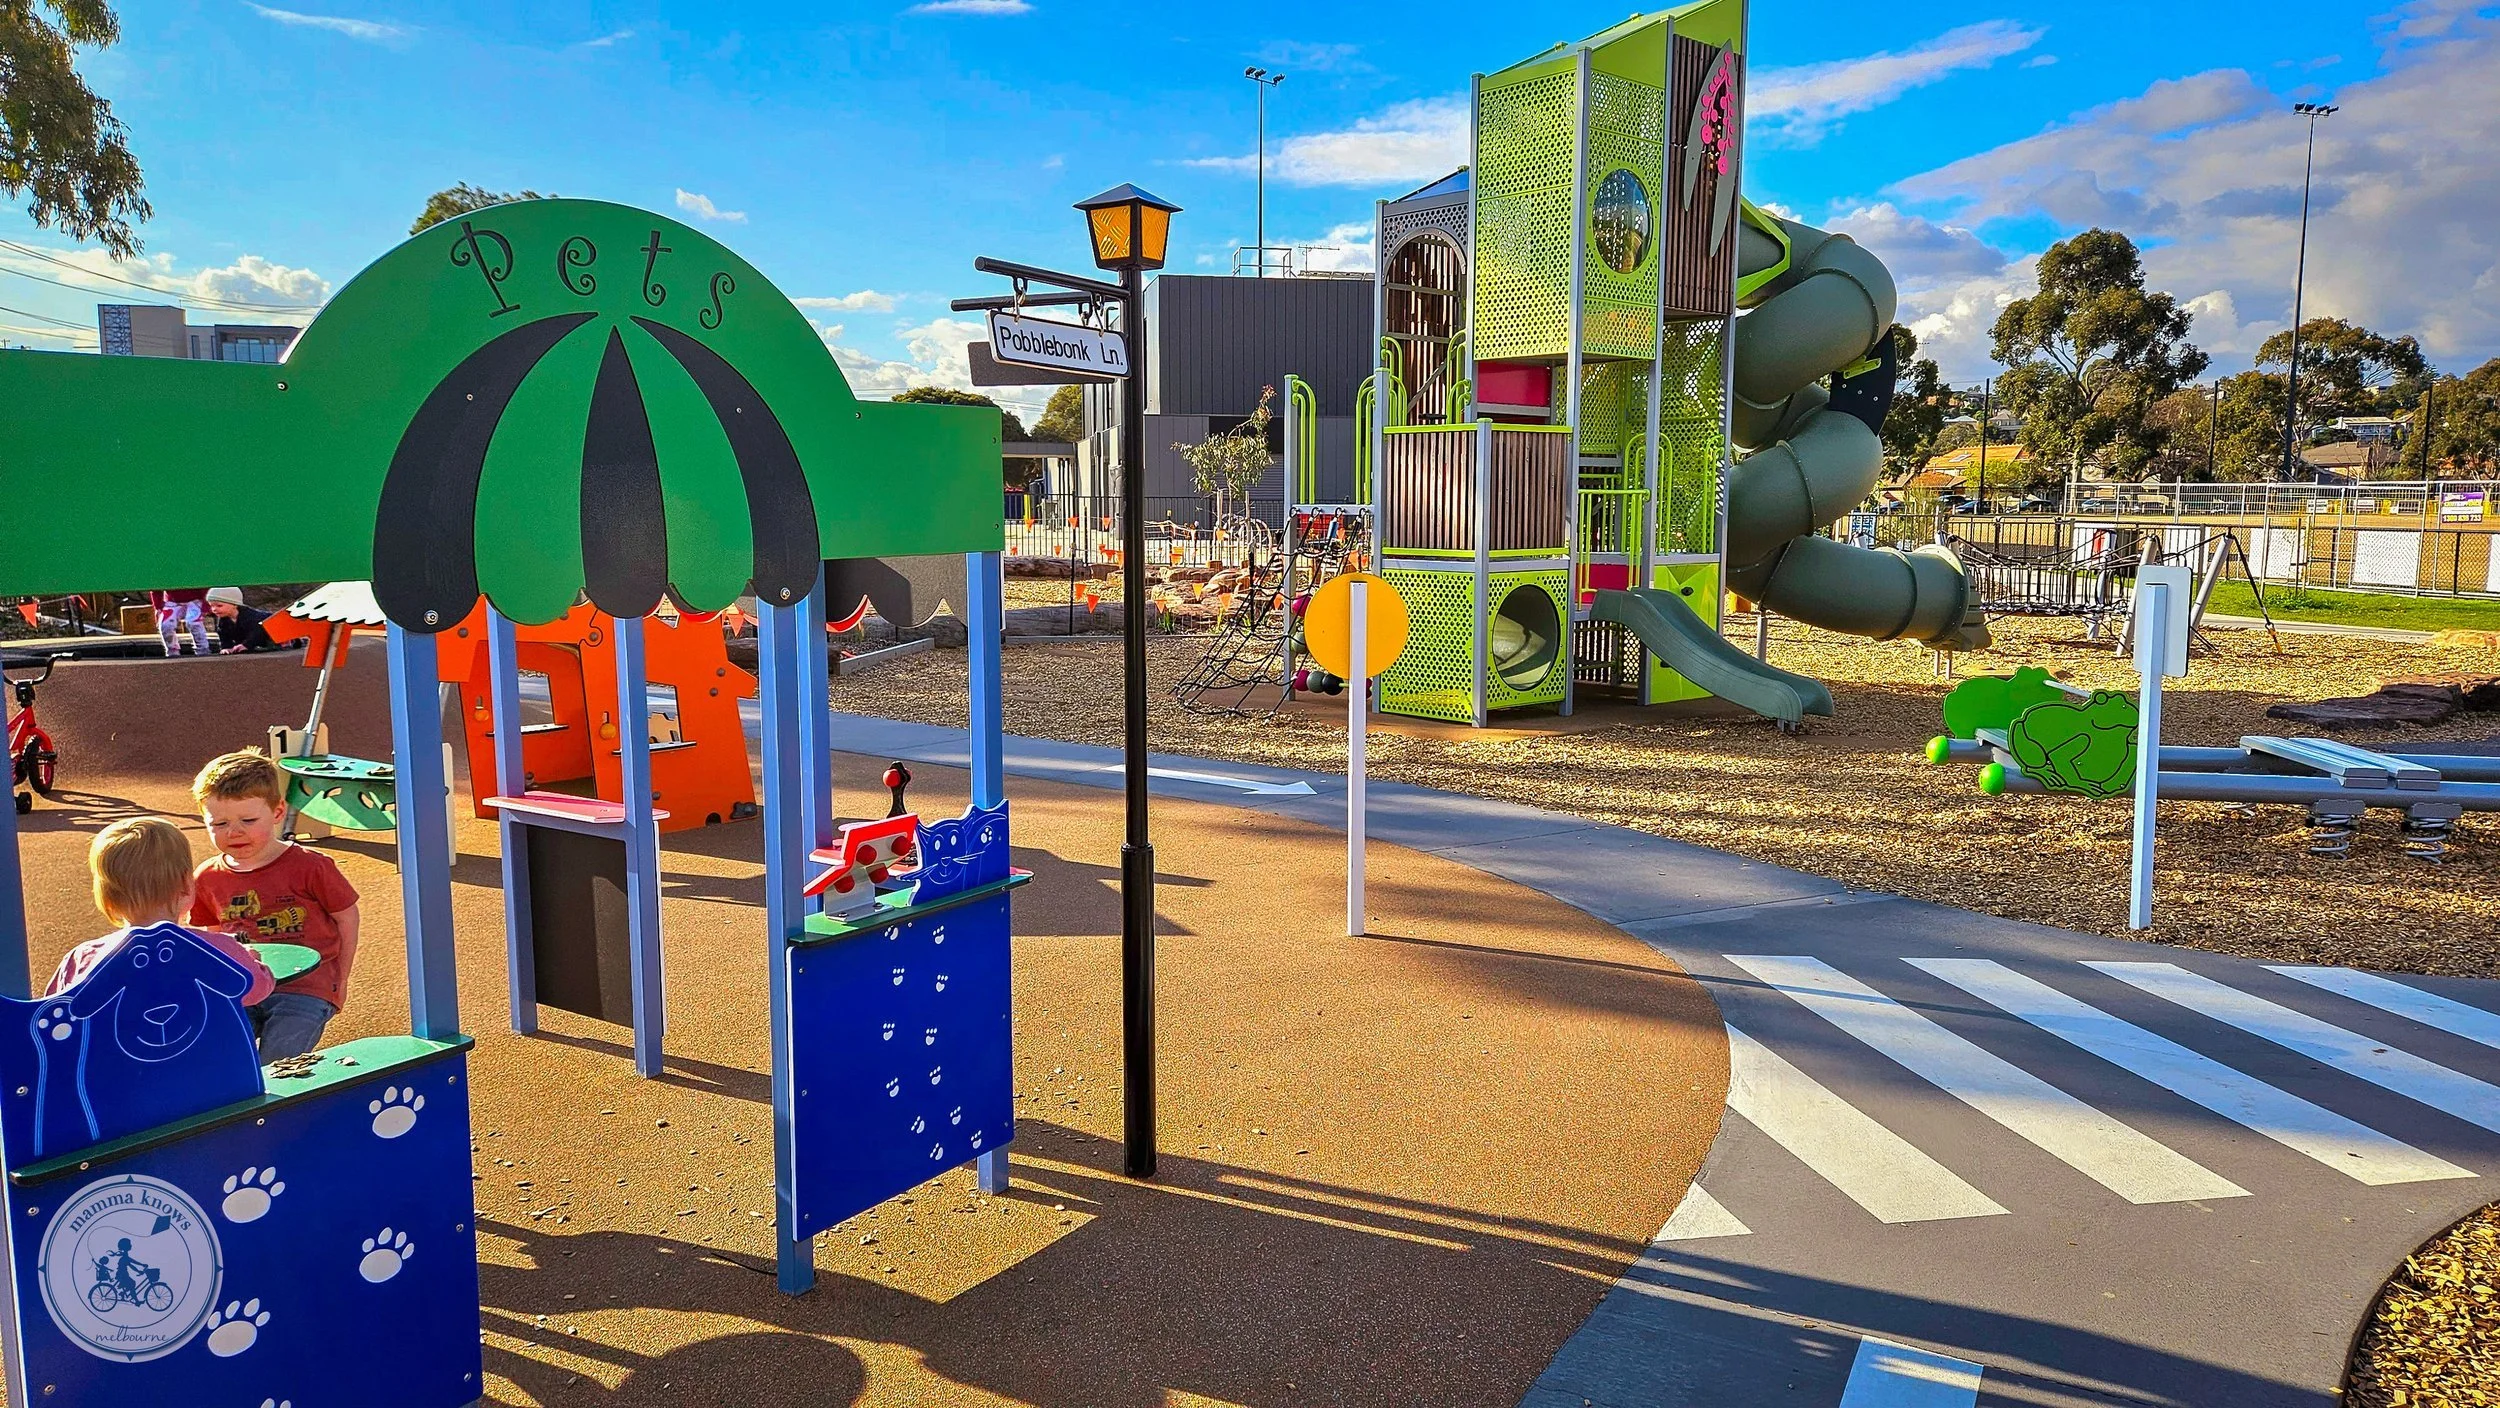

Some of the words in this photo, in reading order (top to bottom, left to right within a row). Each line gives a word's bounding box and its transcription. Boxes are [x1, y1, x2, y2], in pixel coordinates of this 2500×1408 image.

[450, 221, 736, 330] Pets
[999, 325, 1092, 362] Pobblebonk
[1100, 342, 1124, 366] Ln.
[275, 729, 288, 754] 1
